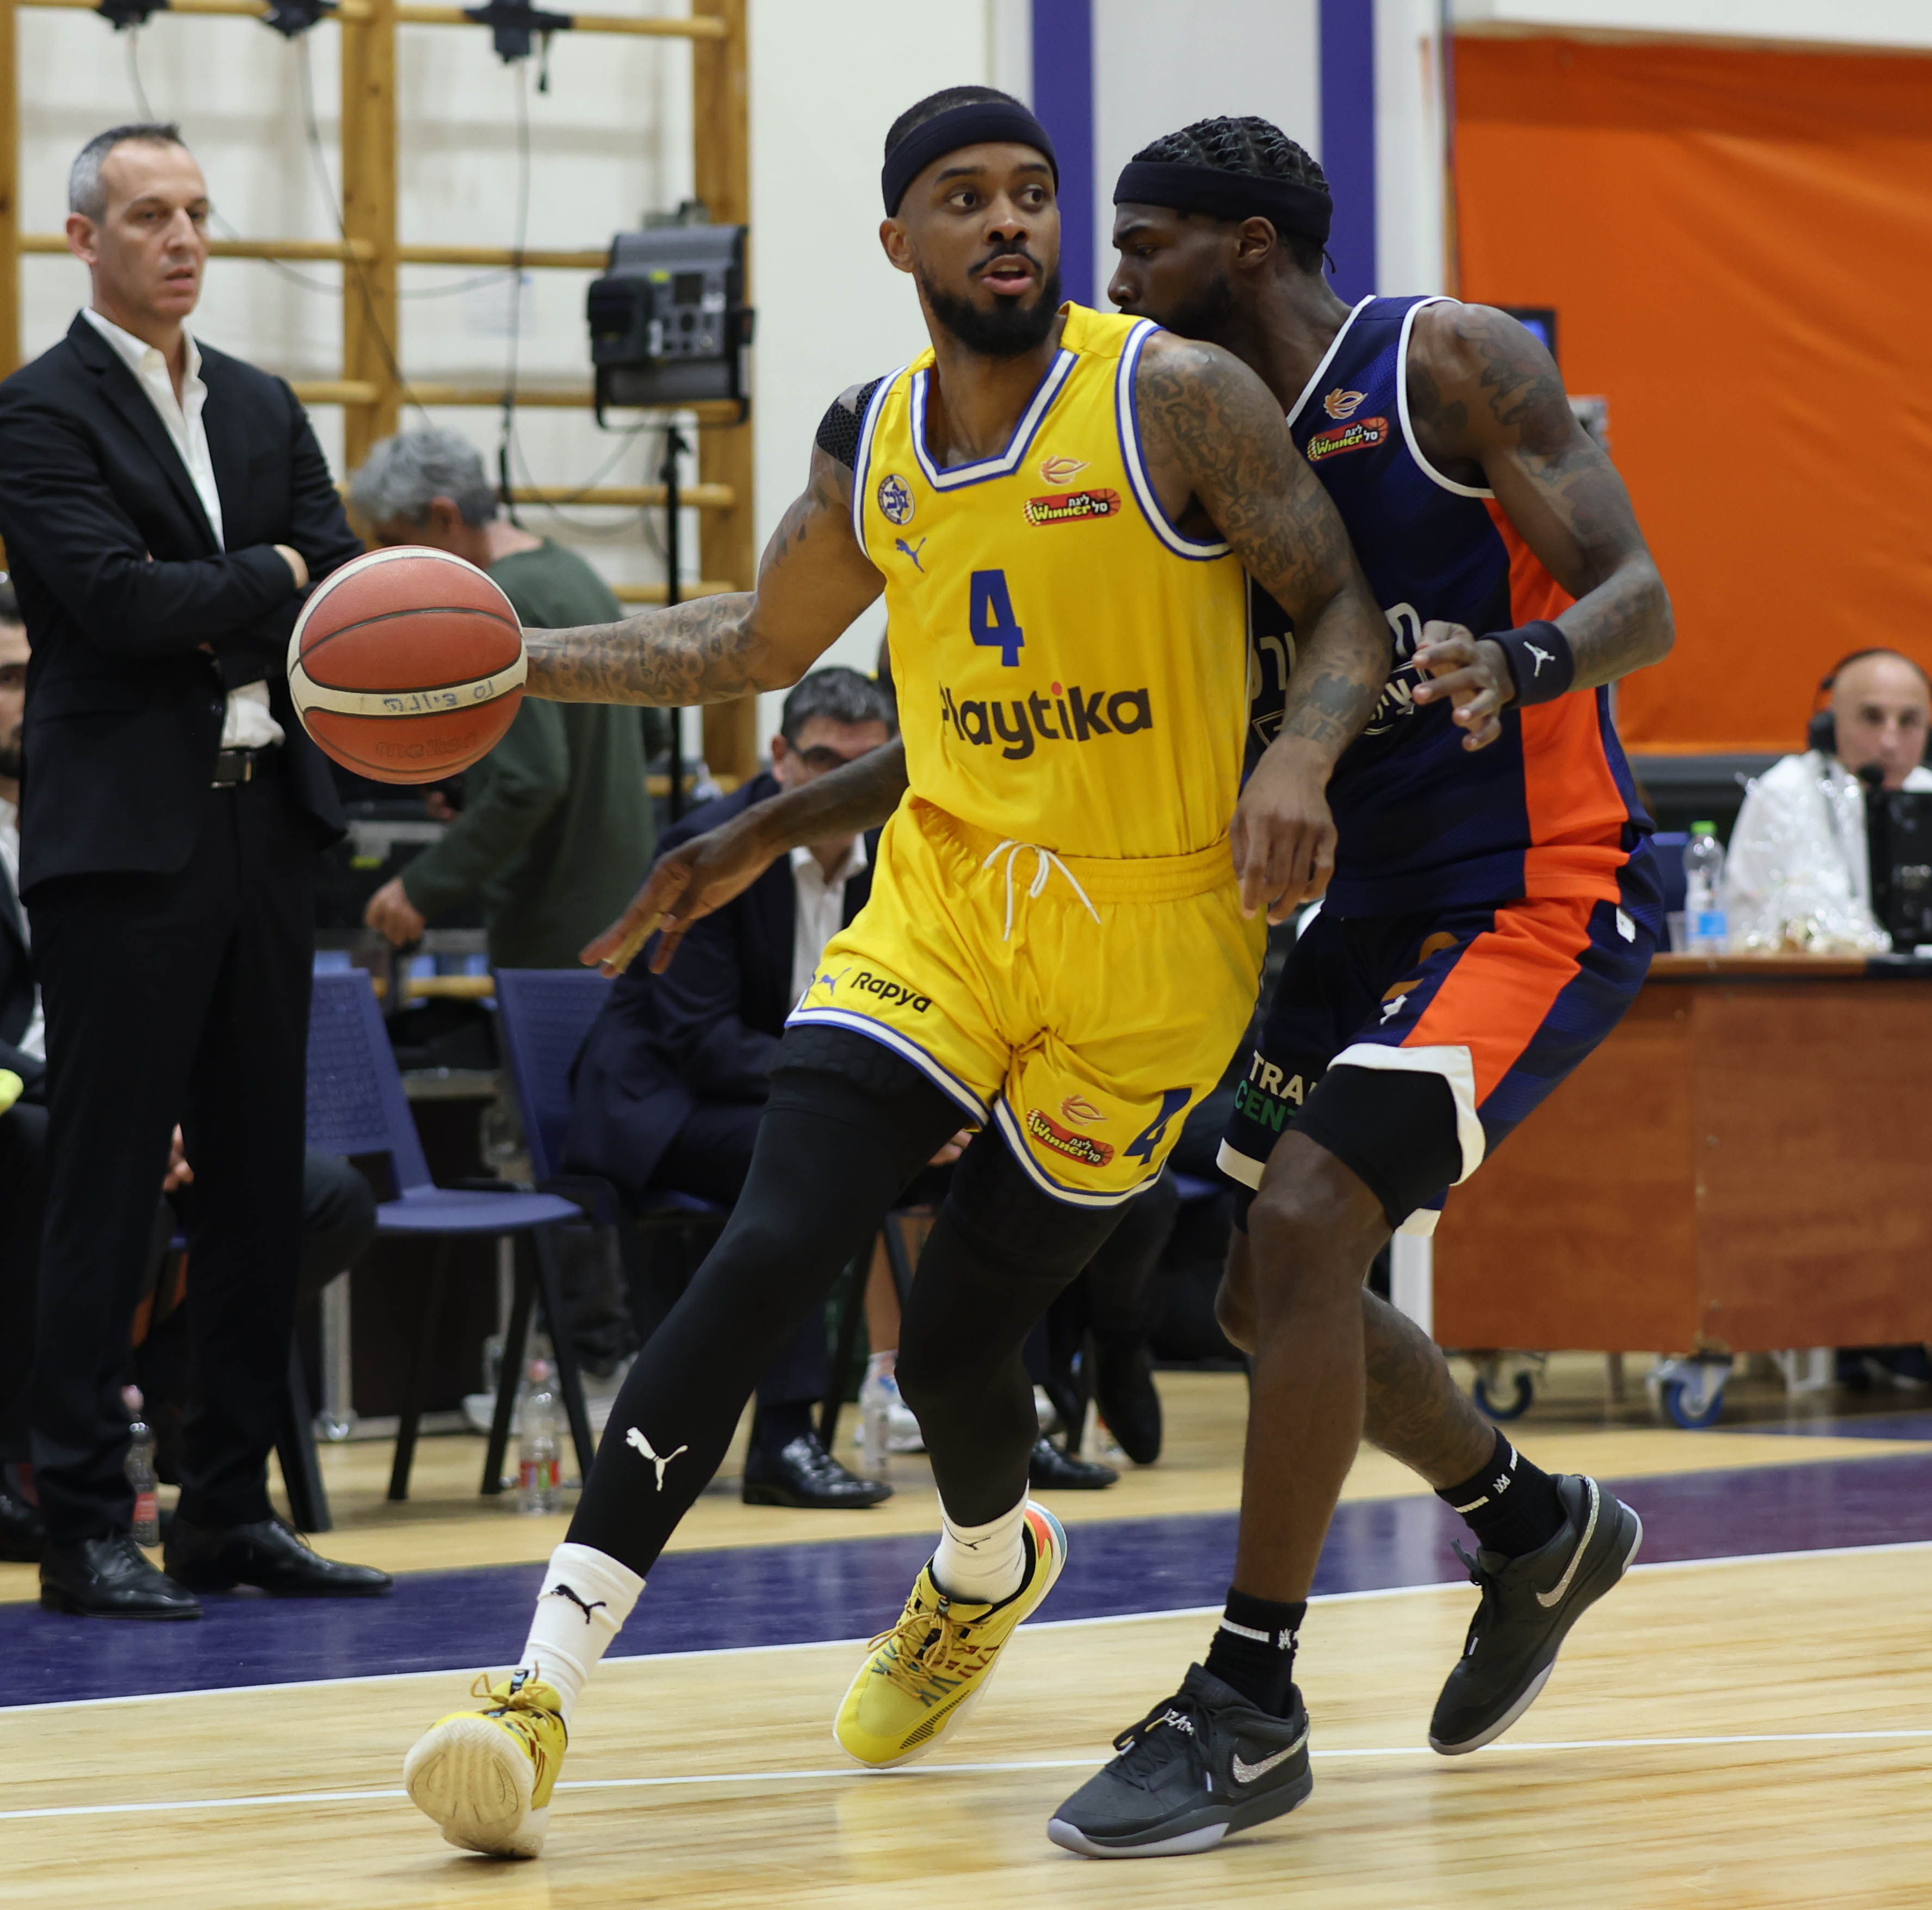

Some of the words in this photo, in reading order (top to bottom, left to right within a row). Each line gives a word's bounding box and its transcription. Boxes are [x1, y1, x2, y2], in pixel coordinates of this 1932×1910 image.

[1316, 434, 1363, 455] Winner
[1364, 430, 1378, 441] סל
[1068, 494, 1089, 506] ליגת
[1092, 500, 1108, 513] סל
[1033, 505, 1091, 520] Winner
[969, 569, 1025, 667] 4
[850, 972, 932, 1013] Rapya
[1249, 1050, 1317, 1106] TRA
[1033, 1118, 1088, 1157] Winner
[1087, 1150, 1101, 1162] סל
